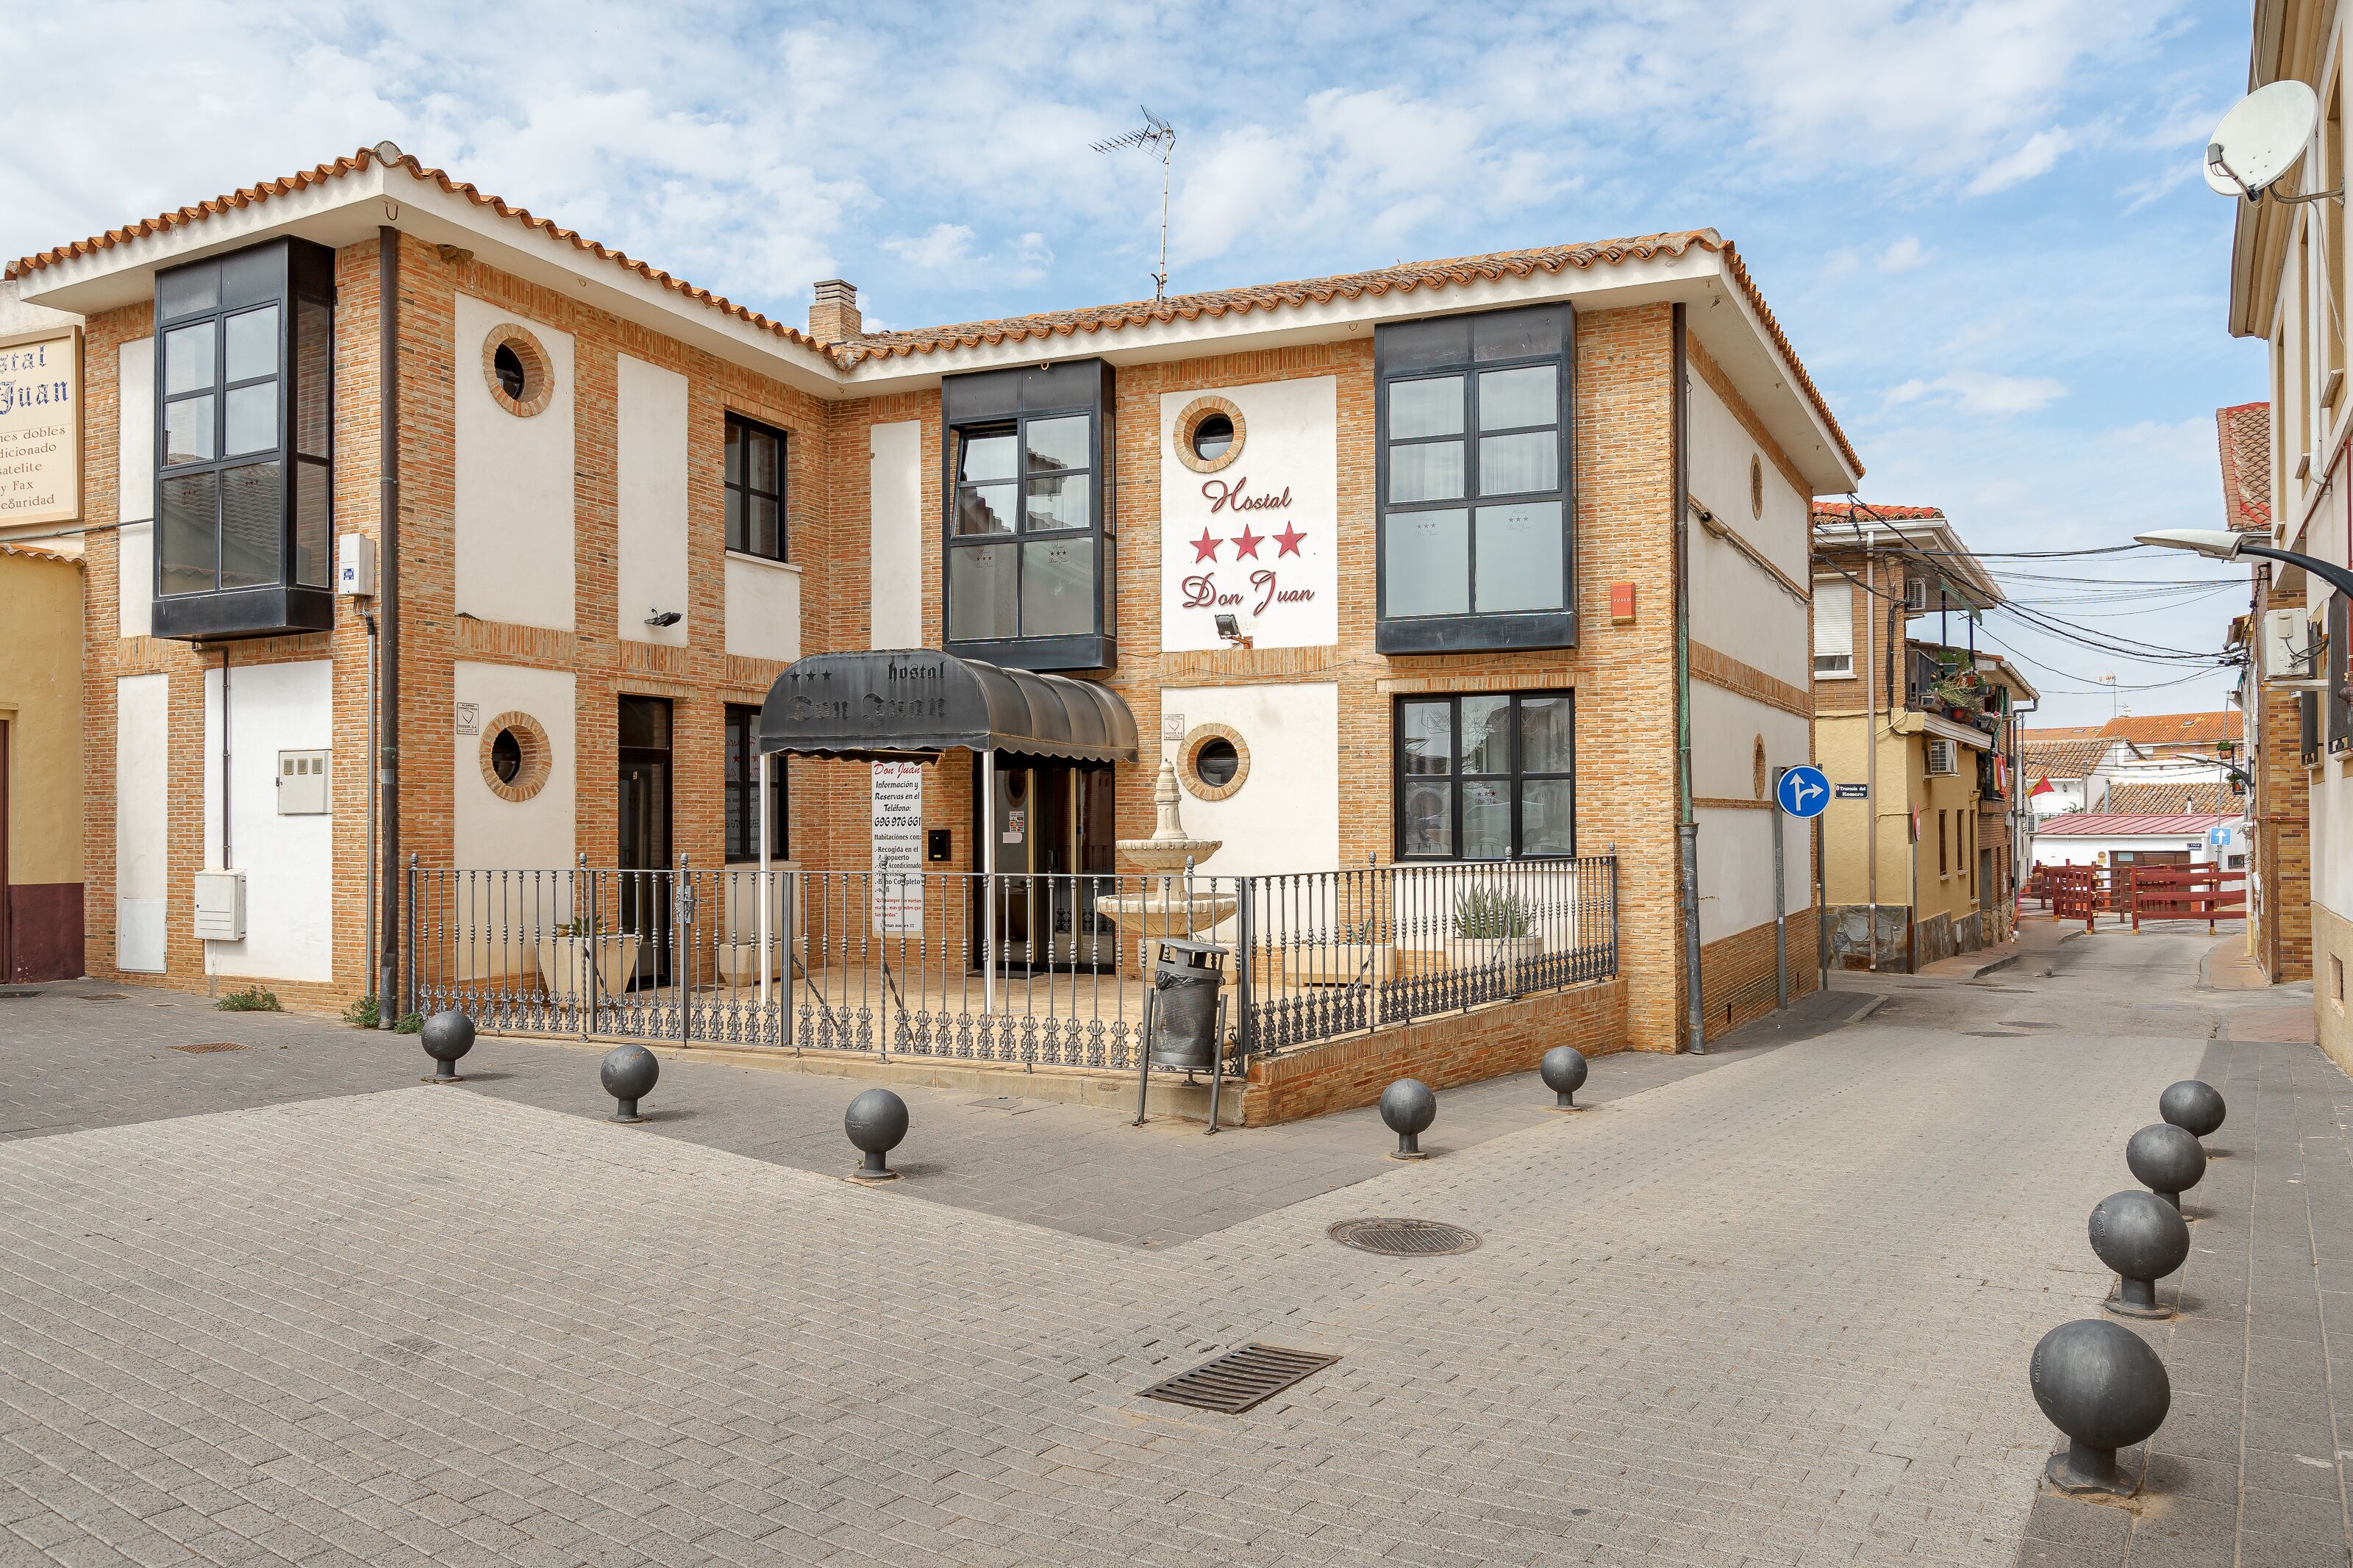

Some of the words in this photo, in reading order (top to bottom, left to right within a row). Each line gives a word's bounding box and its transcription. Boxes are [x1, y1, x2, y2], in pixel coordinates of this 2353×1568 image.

[24, 427, 65, 440] dobles
[1, 485, 7, 497] y
[13, 481, 34, 491] Fax
[1202, 476, 1293, 513] Hostal
[1, 494, 55, 509] eguridad
[1182, 572, 1244, 608] Don
[1249, 570, 1315, 616] Juan
[888, 661, 946, 685] hostal
[788, 694, 851, 724] Don
[861, 692, 947, 728] Juan
[874, 763, 894, 776] Don
[896, 762, 921, 778] Juan
[876, 780, 913, 789] Información
[914, 782, 918, 790] y
[875, 792, 904, 801] Reservas
[914, 792, 920, 800] el
[884, 803, 911, 812] Teléfono:
[874, 817, 890, 827] 696
[891, 817, 906, 827] 976
[907, 816, 921, 827] 661
[893, 878, 921, 887] Copleto
